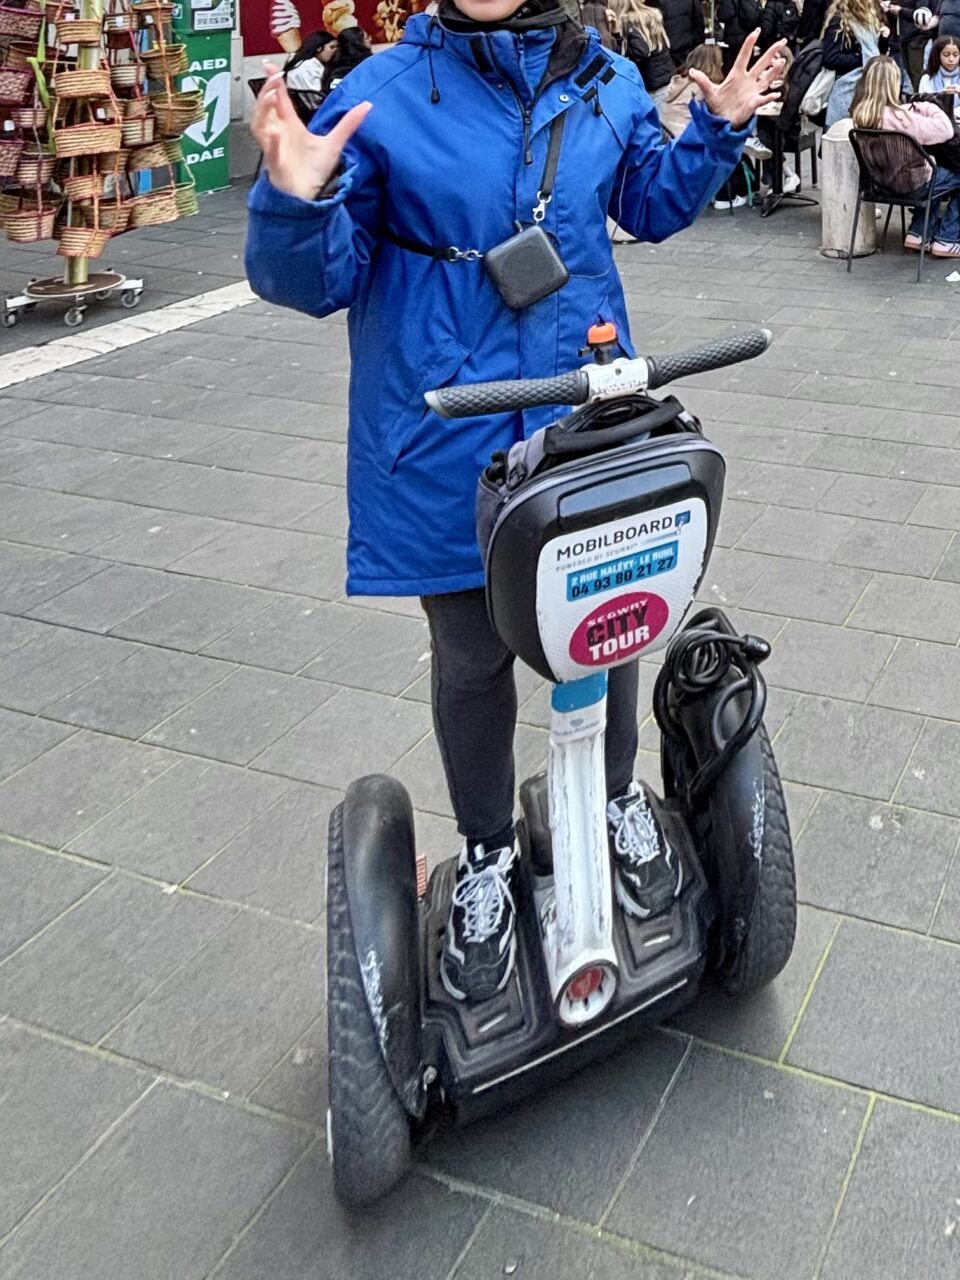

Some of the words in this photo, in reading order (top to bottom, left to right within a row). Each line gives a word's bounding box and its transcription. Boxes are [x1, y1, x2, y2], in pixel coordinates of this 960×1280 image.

[188, 57, 228, 73] AED
[186, 147, 225, 165] DAE
[556, 516, 673, 562] MOBILBOARD
[571, 583, 588, 598] 04
[594, 576, 610, 592] 93
[615, 569, 632, 584] 80
[636, 563, 651, 577] 21
[656, 556, 674, 572] 27
[580, 572, 597, 583] RUE
[640, 553, 650, 564] LE
[586, 598, 649, 627] SEGWAY
[586, 605, 648, 647] CITY
[589, 625, 650, 661] TOUR
